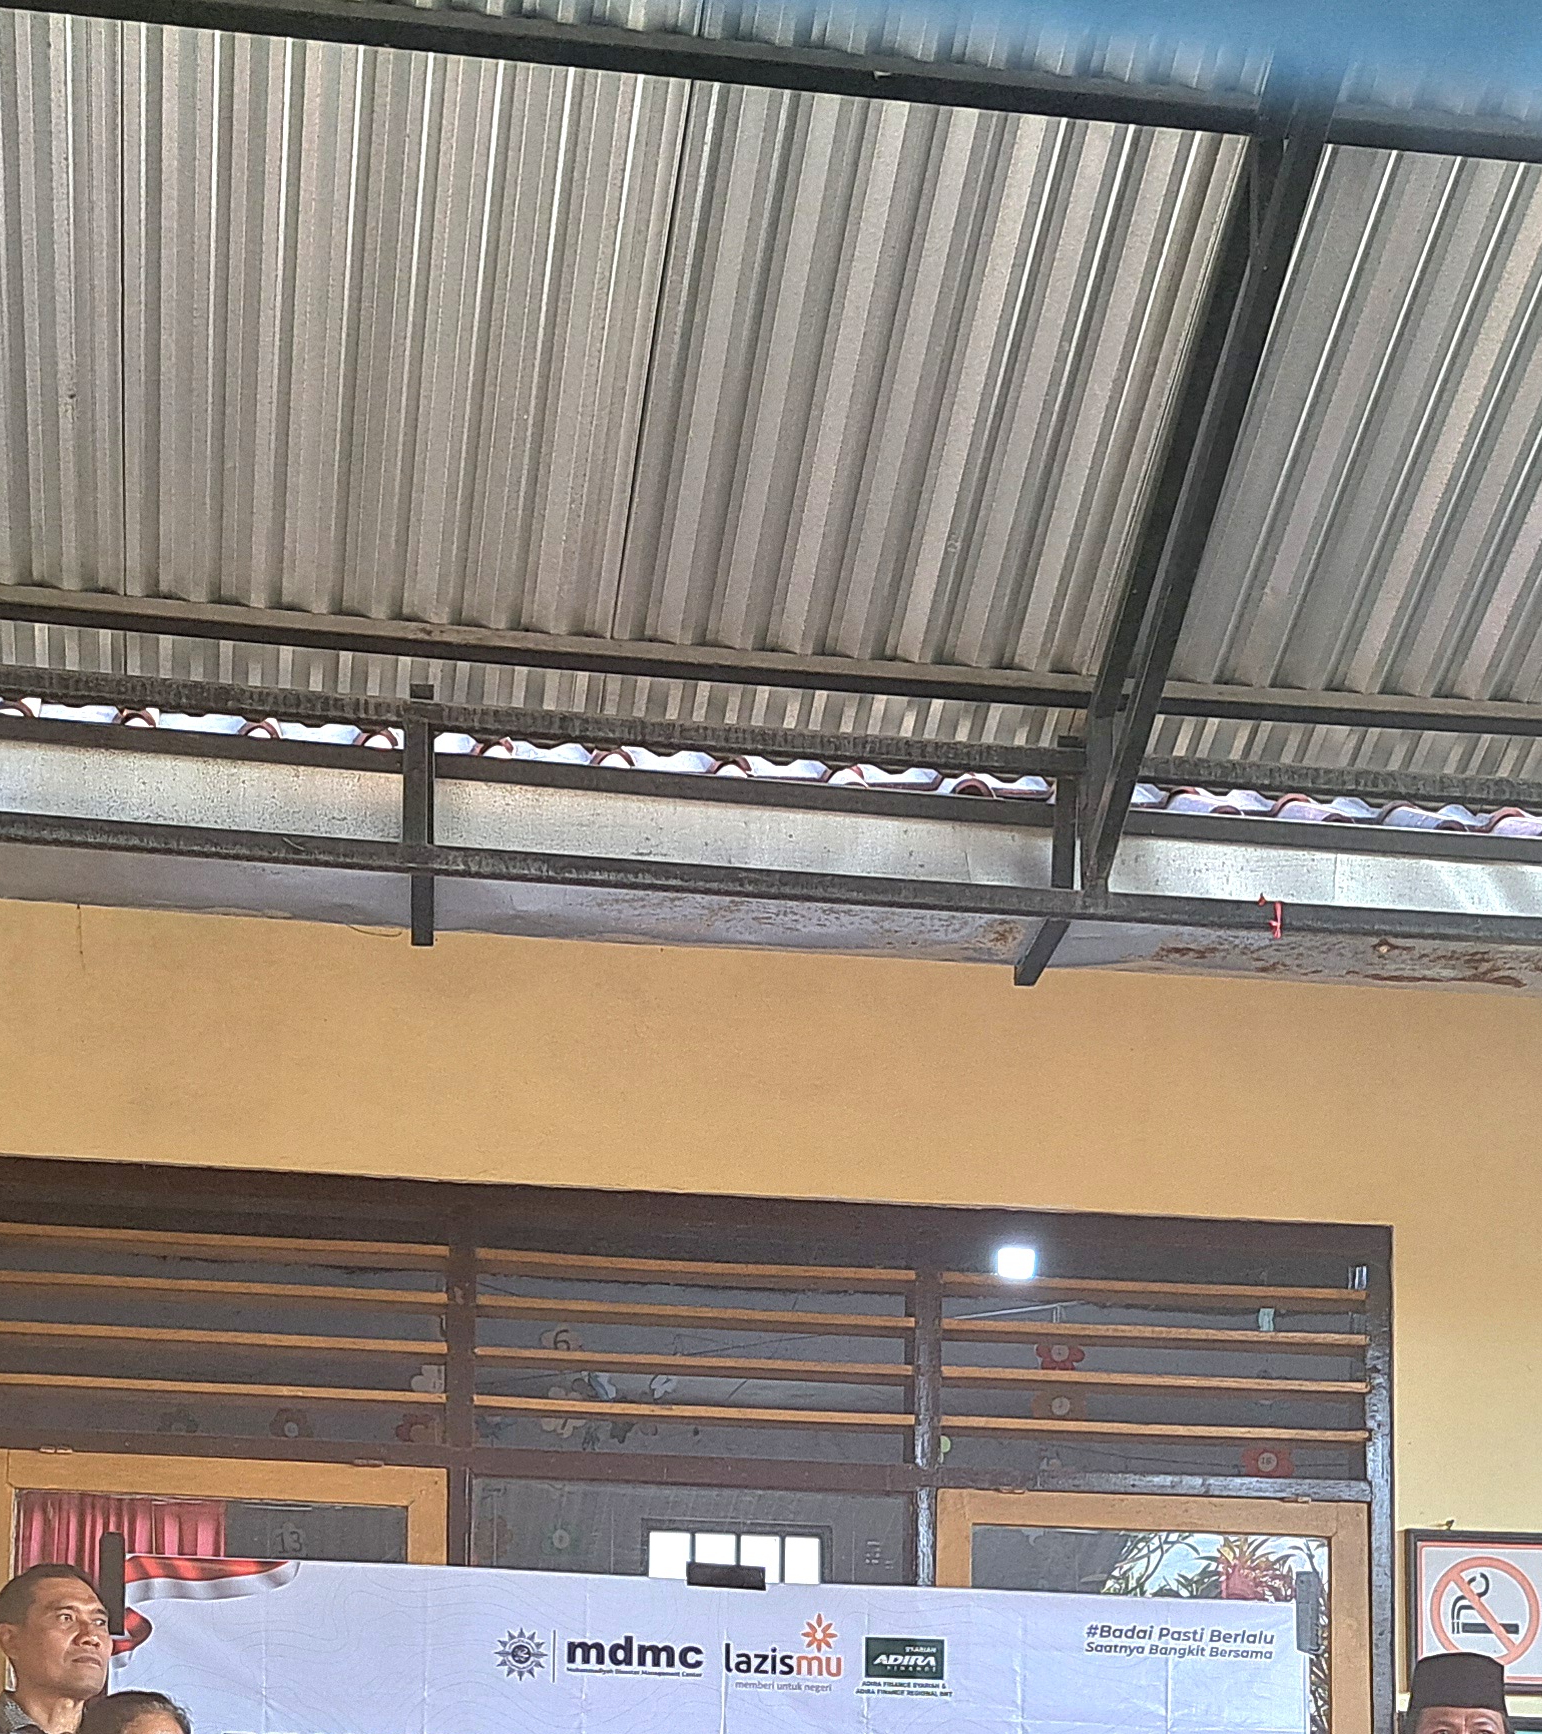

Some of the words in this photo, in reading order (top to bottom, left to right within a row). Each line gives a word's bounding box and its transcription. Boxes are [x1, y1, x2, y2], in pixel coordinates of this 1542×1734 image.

[275, 1530, 302, 1554] 13
[1086, 1624, 1154, 1640] #Badai
[1158, 1627, 1204, 1643] Pasti
[1209, 1629, 1275, 1645] Berlalu
[567, 1635, 703, 1669] mdmc
[724, 1641, 842, 1677] lazismu
[873, 1655, 936, 1666] ADIRA
[1085, 1641, 1145, 1657] Saatnya
[1149, 1644, 1206, 1659] Bangkit
[1209, 1646, 1273, 1660] Bersama
[735, 1680, 774, 1691] memberi
[776, 1681, 803, 1691] untuk
[804, 1683, 832, 1694] negeri
